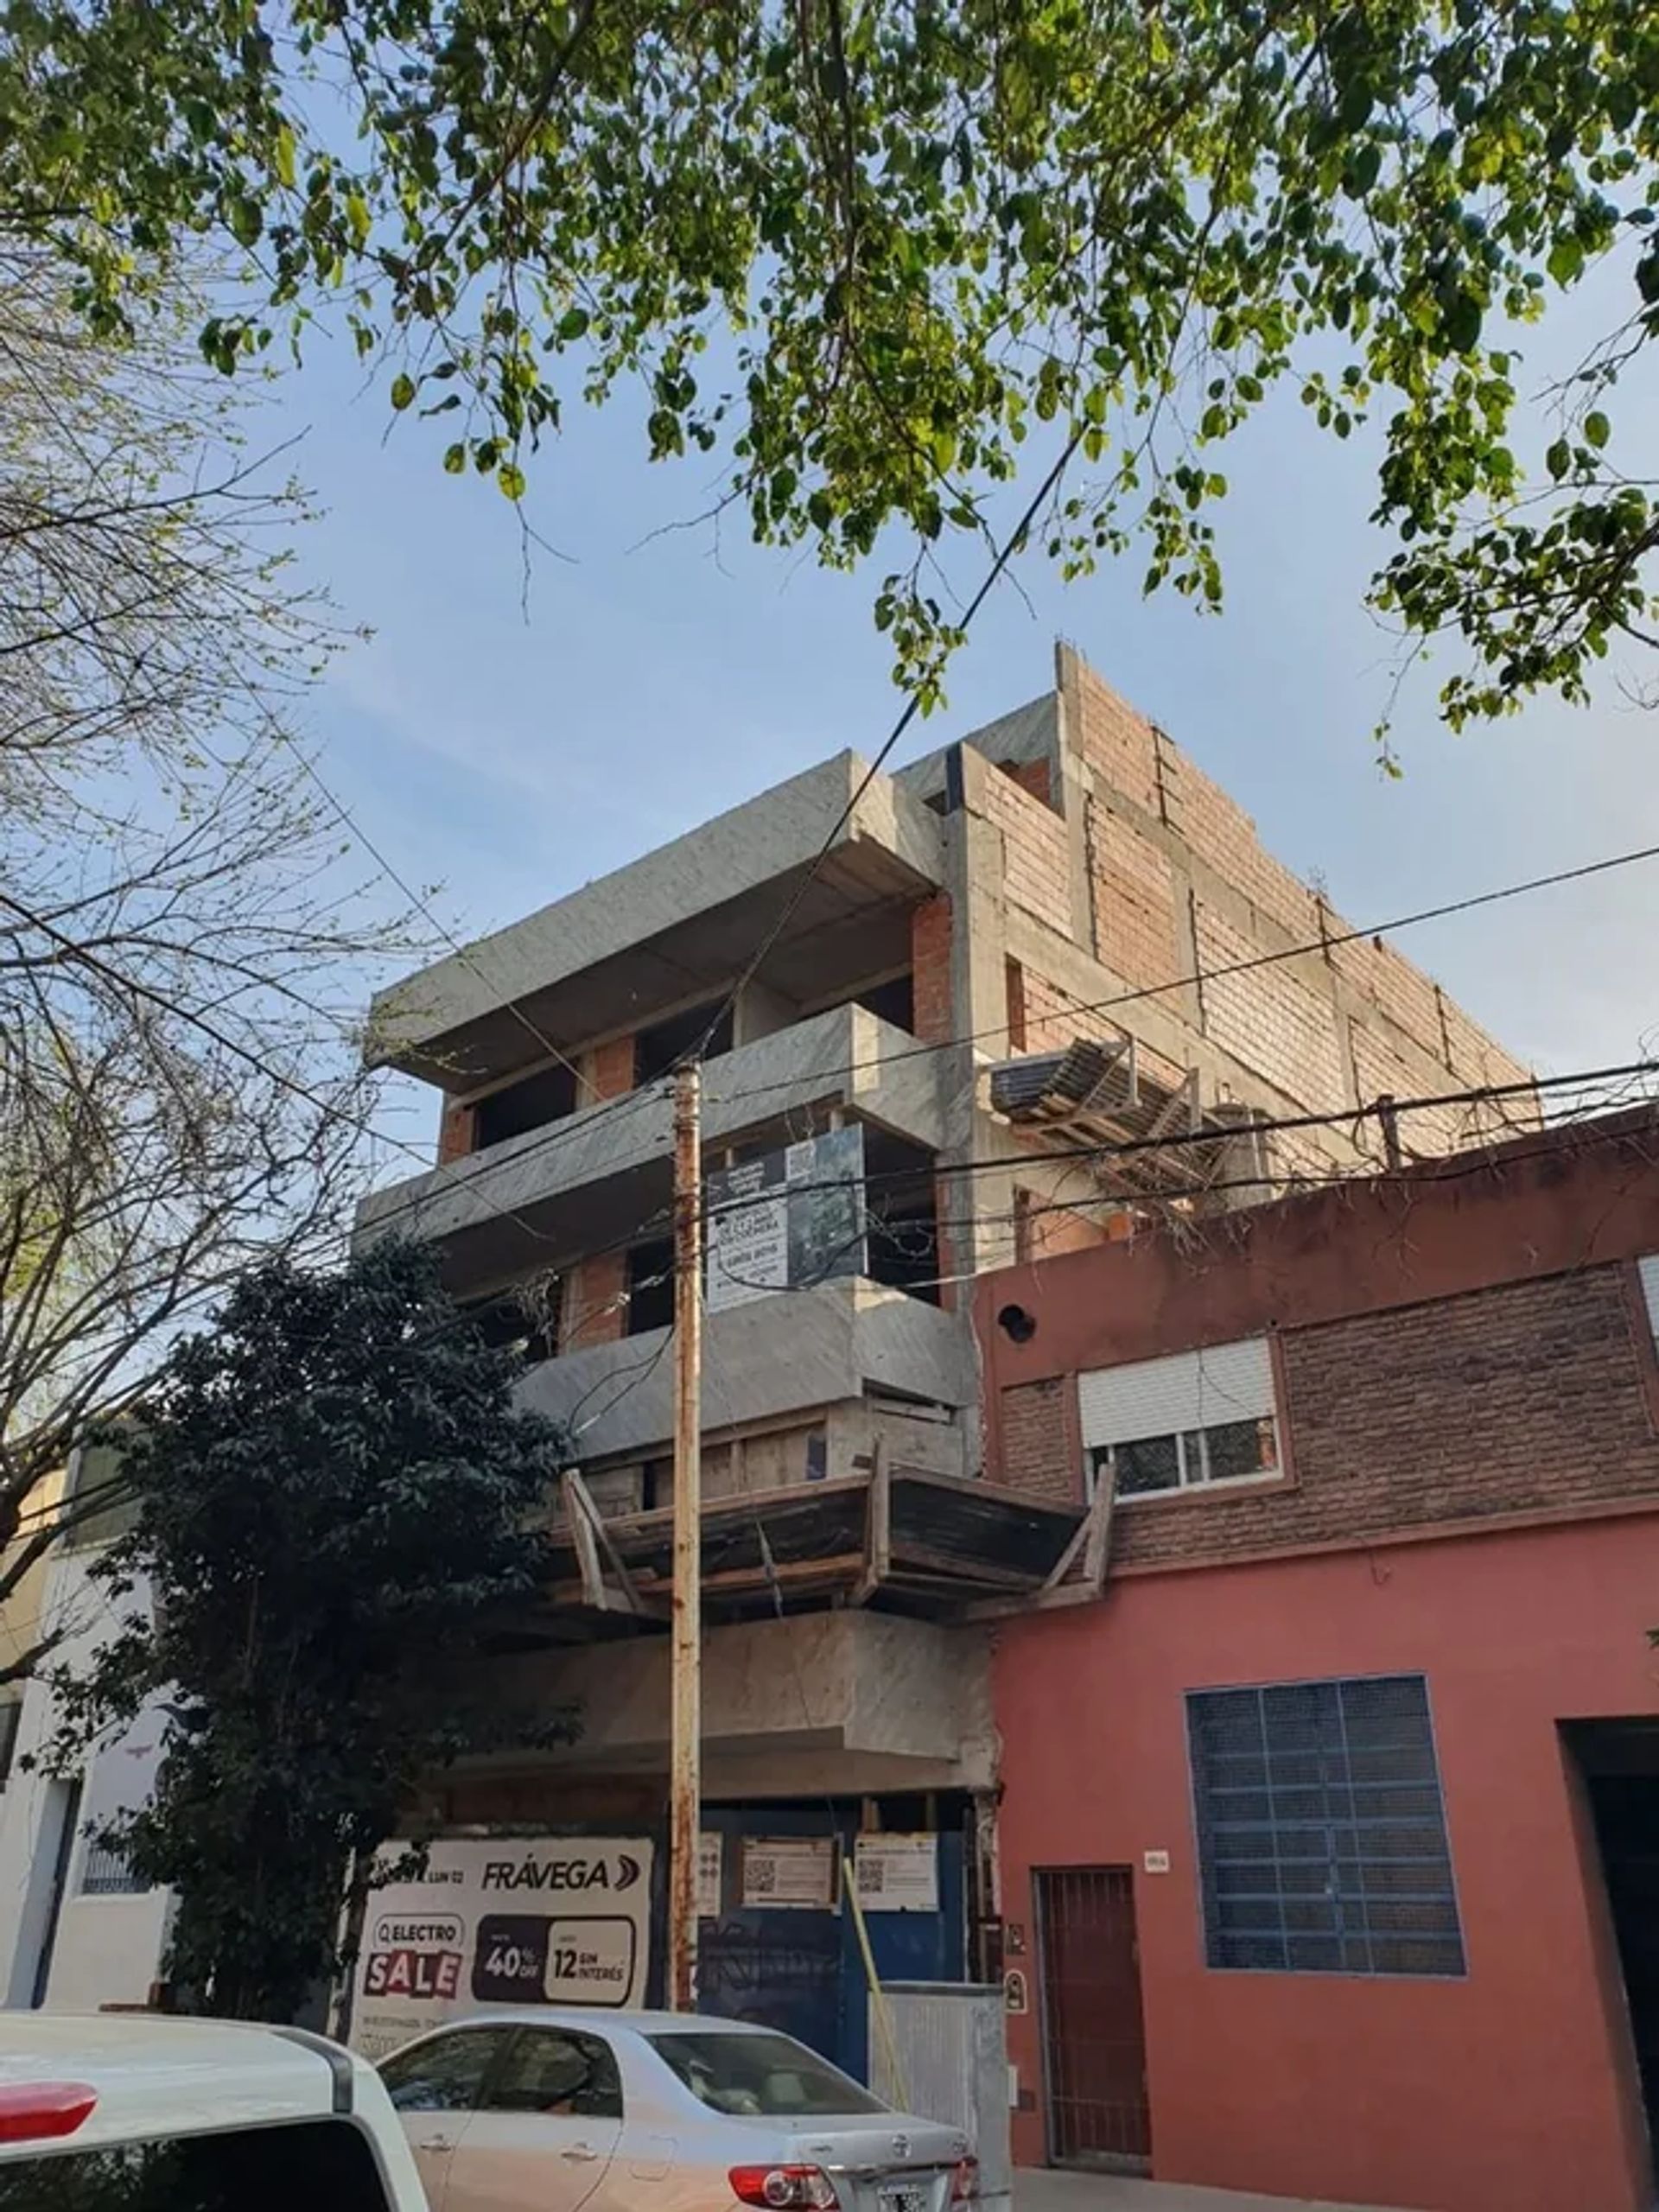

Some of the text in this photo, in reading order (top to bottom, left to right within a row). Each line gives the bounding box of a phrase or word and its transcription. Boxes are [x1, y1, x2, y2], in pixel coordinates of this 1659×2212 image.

[481, 1853, 608, 1890] FRÁVEGA
[392, 1923, 456, 1942] ELECTRO
[368, 1954, 460, 1992] SALE
[485, 1946, 521, 1978] 40
[555, 1949, 576, 1979] 12
